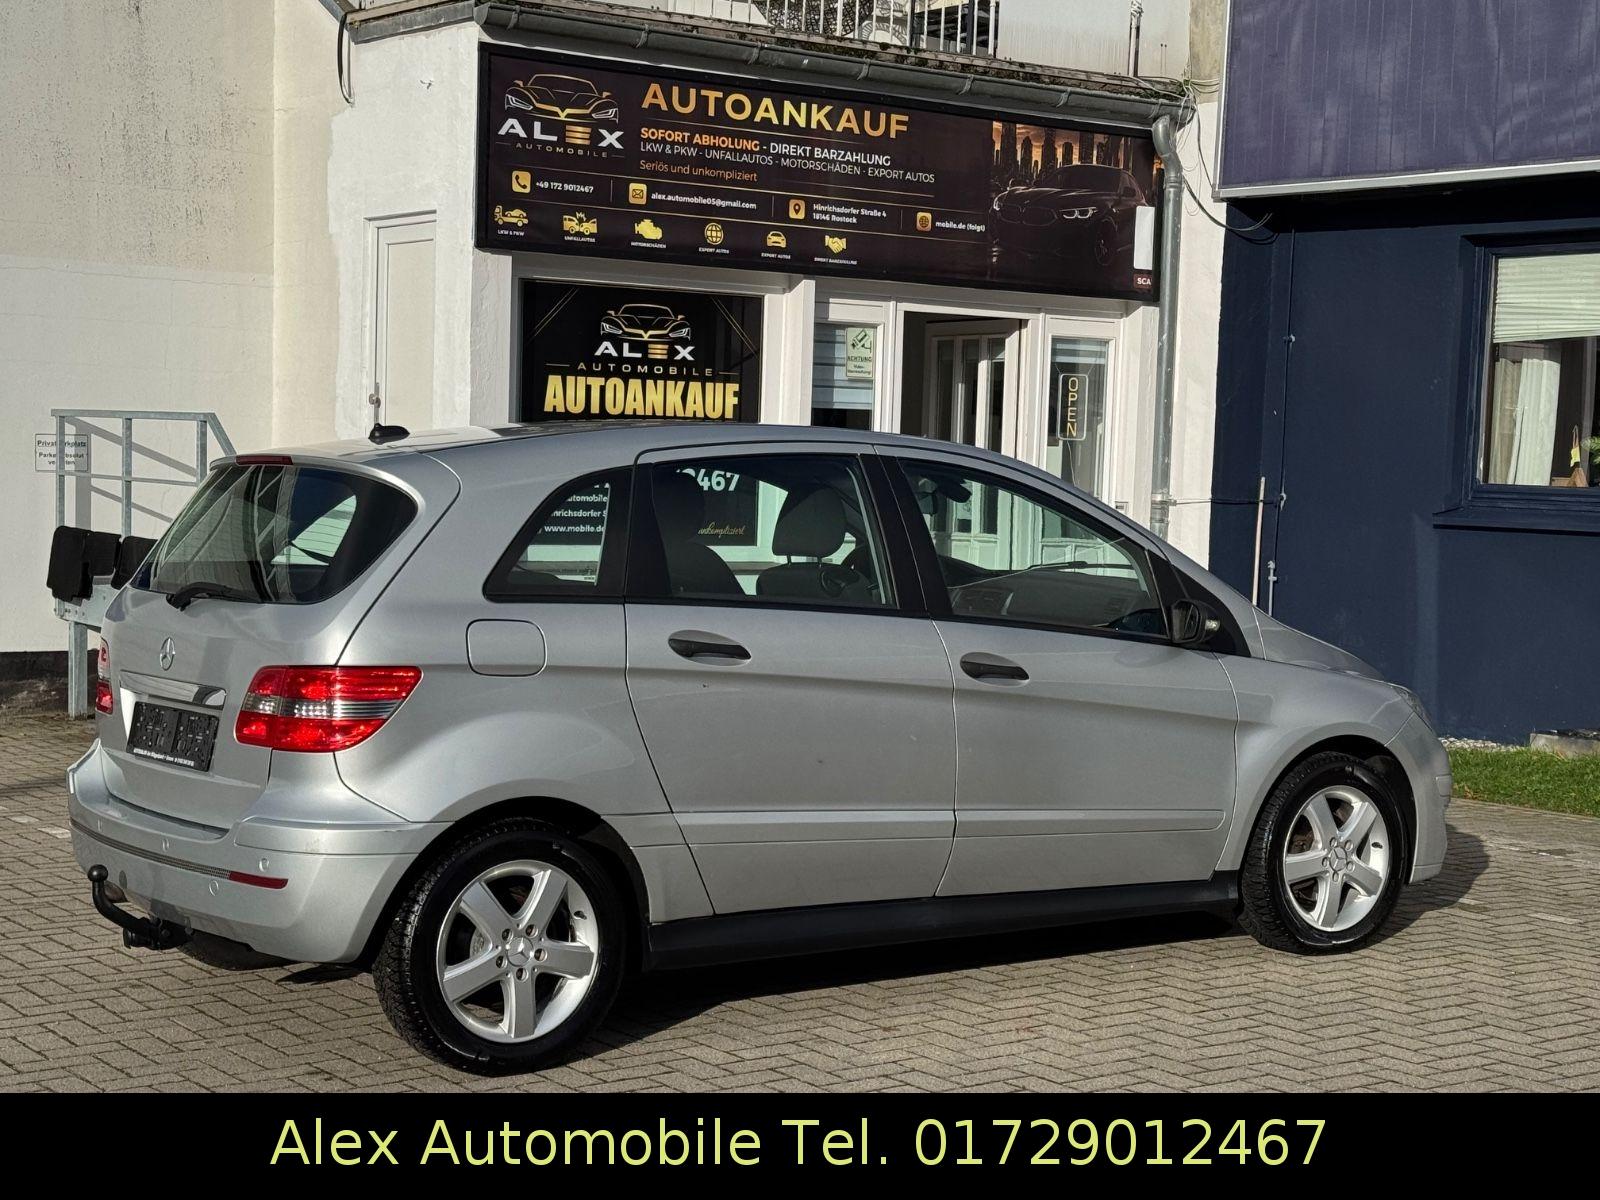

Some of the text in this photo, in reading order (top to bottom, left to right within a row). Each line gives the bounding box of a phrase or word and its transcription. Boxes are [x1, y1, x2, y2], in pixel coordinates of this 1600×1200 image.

[641, 83, 909, 139] AUTOANKAUF
[498, 118, 624, 149] ALEX
[516, 142, 608, 158] AUTOMOBILE
[641, 127, 689, 143] SOFORT
[693, 131, 760, 152] ABHOLUNG
[770, 143, 811, 158] DIREKT
[814, 147, 891, 167] BARZAHLUNG
[640, 141, 665, 154] LKW
[665, 144, 672, 154] &
[674, 145, 698, 157] PKW
[705, 149, 773, 166] UNFALLAUTOS
[781, 156, 861, 175] MOTORSCHÄDEN
[868, 168, 904, 180] EXPORT
[905, 171, 935, 183] AUTOS
[640, 160, 758, 183] Seriös und unkompliziert
[550, 182, 562, 191] 172
[563, 182, 594, 194] 9012467
[651, 191, 757, 210] alex.automobile05@gmail.com
[813, 203, 887, 218] Hinrichsdorfer Straße 4
[831, 214, 857, 224] Rostock
[935, 220, 986, 233] mobile.de (folgt)
[1137, 277, 1152, 285] SCA
[594, 341, 695, 360] ALEX
[577, 362, 713, 376] AUTOMOBILE
[544, 375, 739, 419] AUTOANKAUF
[1067, 377, 1079, 437] OPEN
[676, 468, 740, 491] 467
[567, 494, 608, 502] utomobile
[551, 509, 601, 517] nrichsdorfer
